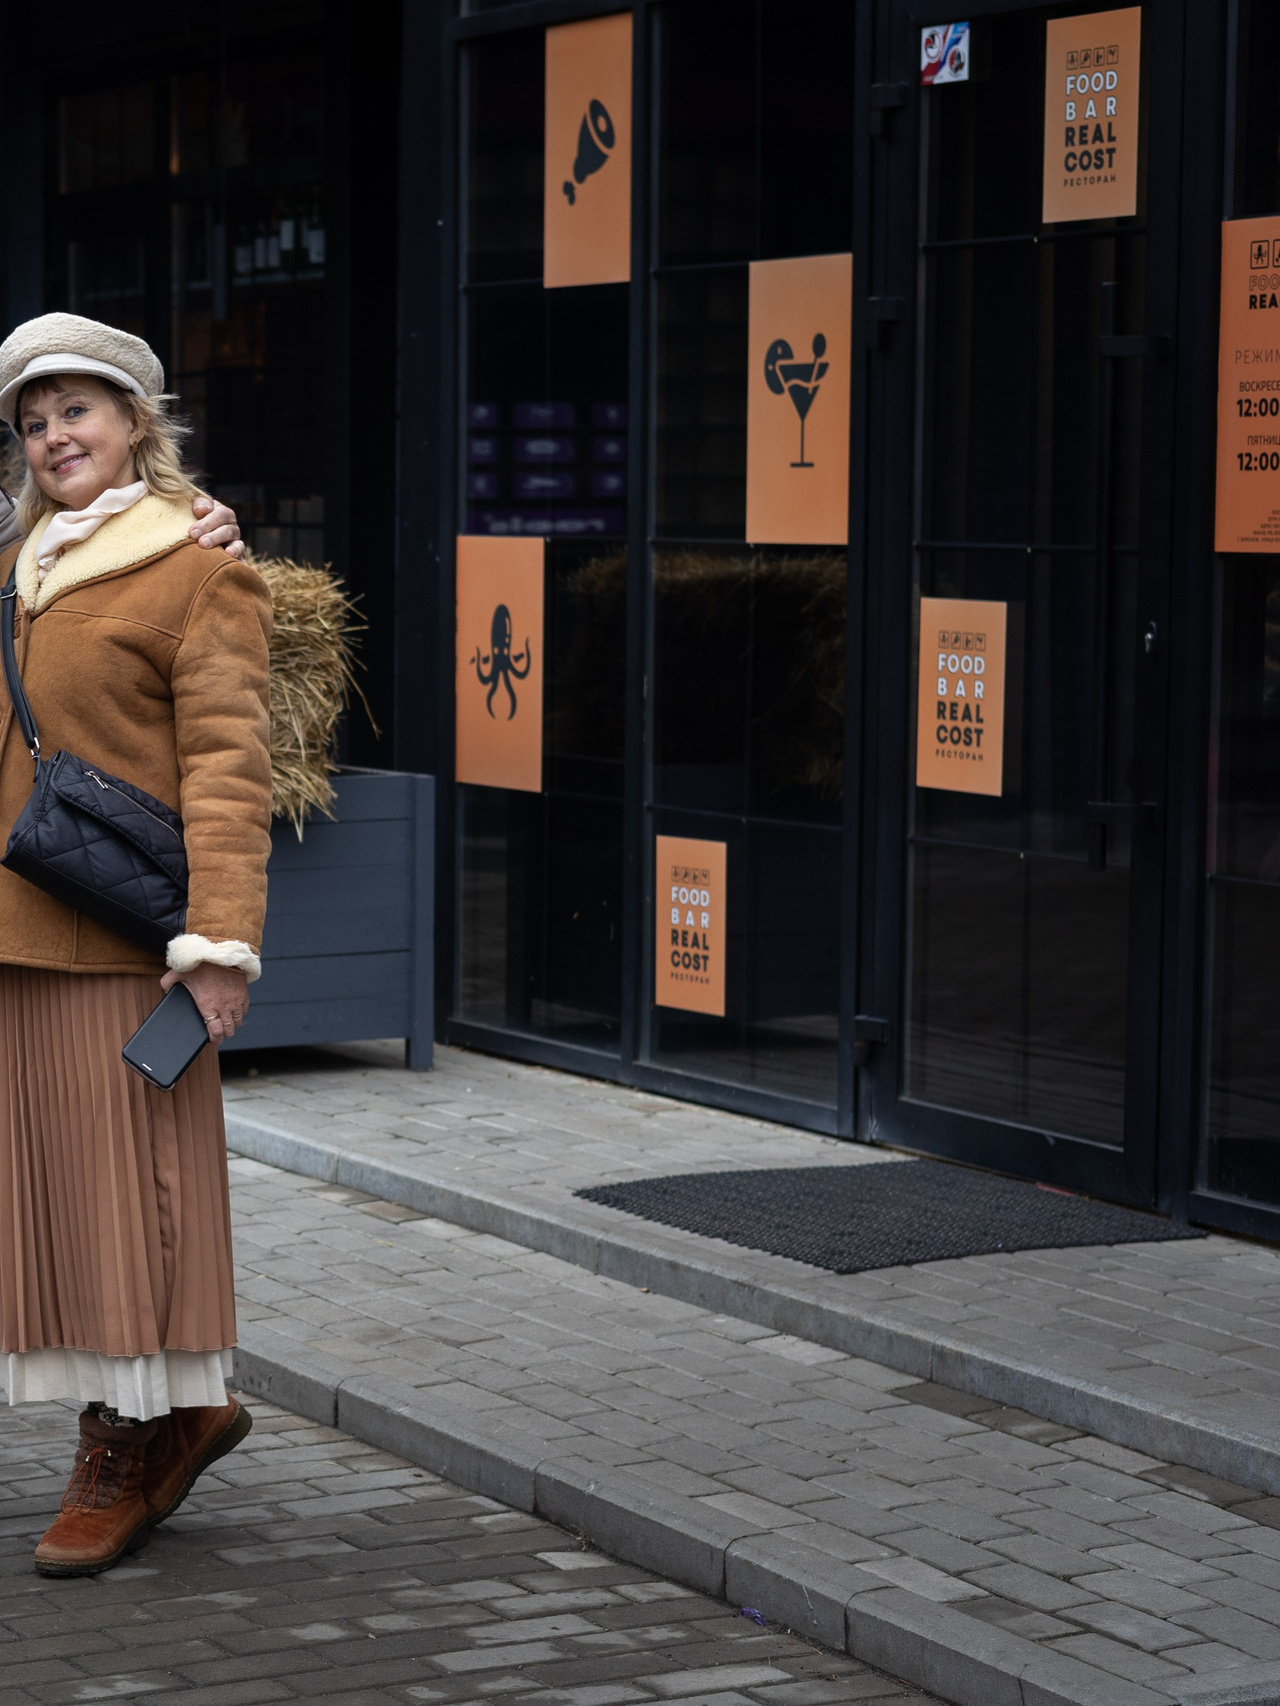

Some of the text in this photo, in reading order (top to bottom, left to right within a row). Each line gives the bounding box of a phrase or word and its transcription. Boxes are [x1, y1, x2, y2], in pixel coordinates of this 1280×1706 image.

[1065, 70, 1118, 96] FOOD
[1065, 96, 1118, 122] BAR
[1064, 122, 1117, 147] REAL
[1064, 148, 1117, 173] COST
[1063, 174, 1117, 187] РЕСТОРАН
[1249, 274, 1280, 291] FOO
[1249, 292, 1280, 309] REA
[1237, 398, 1280, 417] 12:00
[1237, 452, 1280, 471] 12:00
[937, 653, 986, 675] FOOD
[937, 676, 985, 699] BAR
[936, 700, 984, 724] REAL
[936, 724, 984, 748] COST
[935, 749, 983, 761] РЕСТОРАН
[671, 885, 710, 907] FOOD
[671, 907, 710, 929] BAR
[671, 929, 710, 950] REAL
[671, 950, 710, 973] COST
